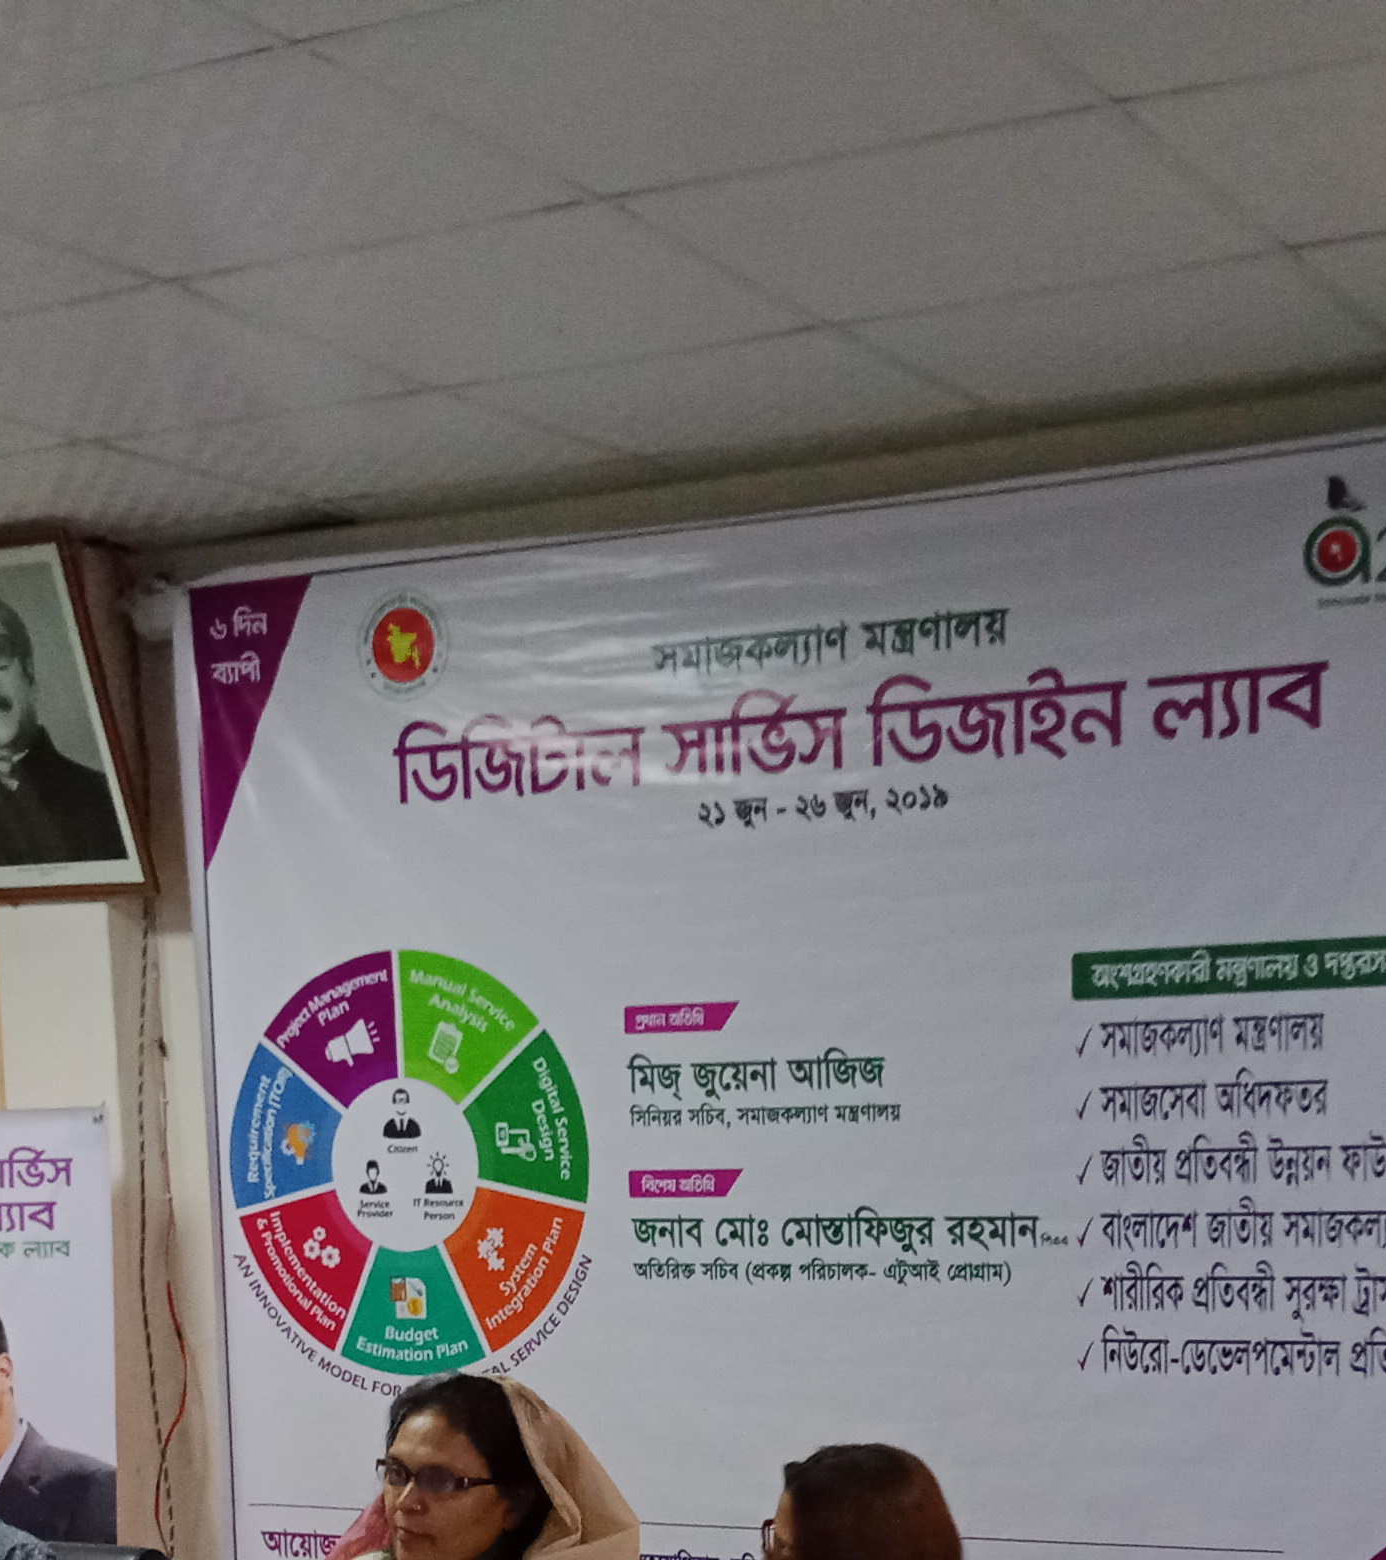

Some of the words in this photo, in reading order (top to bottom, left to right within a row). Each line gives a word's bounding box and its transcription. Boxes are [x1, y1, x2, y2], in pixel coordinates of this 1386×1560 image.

[209, 619, 227, 640] ৬
[232, 606, 269, 638] দিন
[652, 623, 848, 677] সমাজকল্যাণ
[860, 606, 1010, 657] মন্ত্রণালয়
[210, 650, 262, 686] ব্যাপী
[392, 713, 645, 805] ডিজিটাল
[660, 687, 847, 778] সার্ভিস
[866, 667, 1127, 768] ডিজাইন
[1147, 660, 1330, 742] ল্যাব
[697, 802, 725, 829] ২১
[734, 796, 768, 830] জুন
[794, 794, 827, 821] ২৬
[886, 782, 949, 813] ২০১৯
[1090, 950, 1212, 990] অংশগ্রহণকারী
[1215, 953, 1300, 989] মন্ত্রণালয়
[1303, 953, 1319, 977] ও
[276, 1006, 312, 1049] Project
[307, 968, 389, 1014] Management
[316, 1000, 350, 1027] Plan
[410, 968, 469, 1000] Manual
[467, 988, 517, 1033] Service
[427, 993, 490, 1035] Analysis
[1099, 1014, 1225, 1059] সমাজকল্যাণ
[1232, 1012, 1325, 1053] মন্ত্রণালয়
[627, 1053, 682, 1099] মিজ্
[690, 1056, 777, 1099] জুয়েনা
[787, 1047, 886, 1091] আজিজ
[1098, 1081, 1207, 1123] সমাজসেবা
[1215, 1067, 1329, 1121] অধিদফতর
[247, 1074, 272, 1184] Requirement
[530, 1098, 555, 1164] Design
[531, 1055, 561, 1113] Digital
[551, 1115, 573, 1182] Service
[629, 1104, 683, 1129] সিনিয়র
[688, 1103, 731, 1129] সচিব,
[737, 1103, 829, 1126] সমাজকল্যাণ
[834, 1102, 902, 1123] মন্ত্রণালয়
[1099, 1133, 1168, 1187] জাতীয়
[1173, 1130, 1260, 1187] প্রতিবন্ধী
[1266, 1139, 1333, 1187] উন্নয়ন
[256, 1217, 268, 1231] &
[357, 1208, 394, 1218] Provider
[359, 1199, 391, 1209] Service
[423, 1211, 456, 1220] Person
[1099, 1208, 1199, 1253] বাংলাদেশ
[1205, 1195, 1275, 1249] জাতীয়
[23, 1239, 71, 1259] ল্যাব
[631, 1211, 704, 1248] জনাব
[715, 1212, 769, 1248] মোঃ
[781, 1205, 936, 1255] মোস্তাফিজুর
[944, 1210, 1040, 1251] রহমান
[261, 1230, 313, 1312] Promotional
[269, 1210, 348, 1320] Implementation
[484, 1255, 550, 1331] Integration
[541, 1216, 564, 1256] Plan
[499, 1242, 539, 1297] System
[633, 1257, 696, 1282] অতিরিক্ত
[701, 1257, 739, 1282] সচিব
[744, 1259, 793, 1286] (প্রকল্প
[883, 1257, 941, 1285] এটুআই
[947, 1259, 1013, 1286] প্রোগ্রাম)
[1100, 1260, 1185, 1314] শারীরিক
[1190, 1259, 1276, 1315] প্রতিবন্ধী
[1282, 1274, 1348, 1322] সুরক্ষা
[233, 1253, 255, 1279] AN
[248, 1279, 319, 1362] INNOVATIVE
[317, 1356, 368, 1391] MODEL
[309, 1303, 338, 1332] Plan
[384, 1324, 440, 1347] Budget
[509, 1312, 562, 1368] SERVICE
[555, 1253, 594, 1317] DESIGN
[356, 1334, 435, 1363] Estimation
[435, 1338, 470, 1360] Plan
